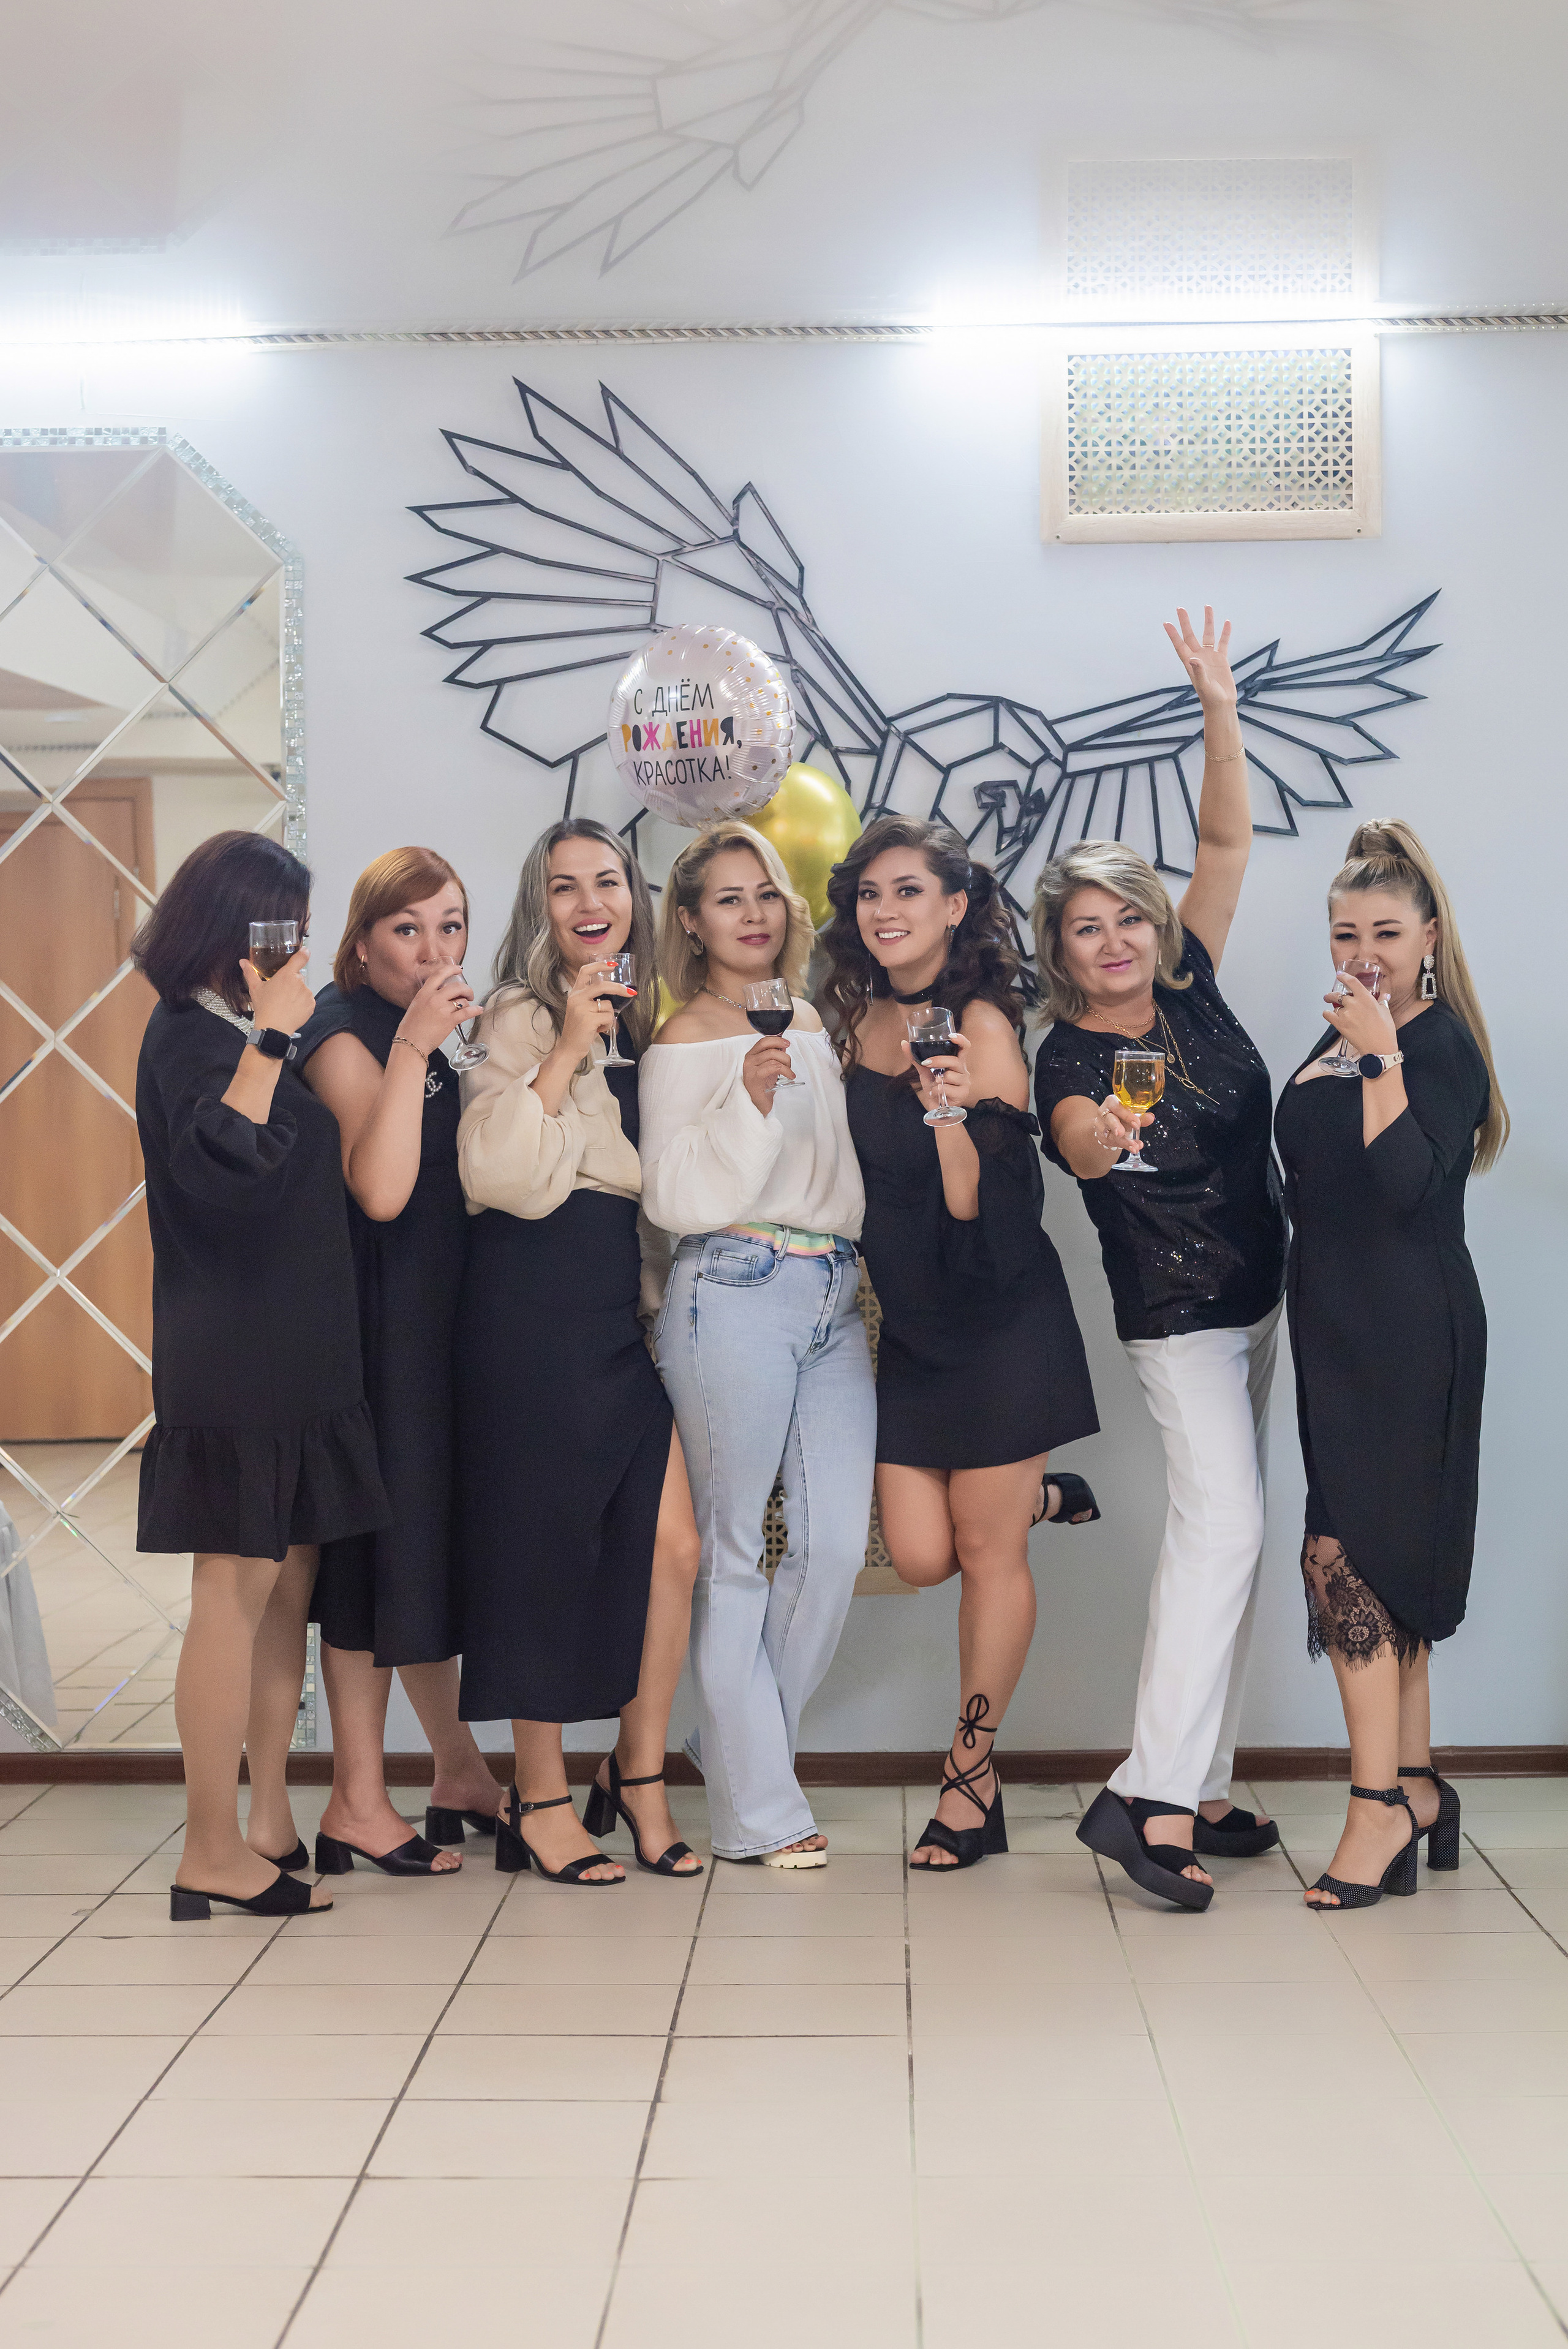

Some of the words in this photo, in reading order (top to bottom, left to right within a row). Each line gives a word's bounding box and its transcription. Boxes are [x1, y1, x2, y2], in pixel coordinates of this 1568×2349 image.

[652, 679, 714, 716] ДНЁМ
[622, 717, 742, 752] РОЖДЕНИЯ,
[633, 755, 732, 786] КРАСОТКА!
